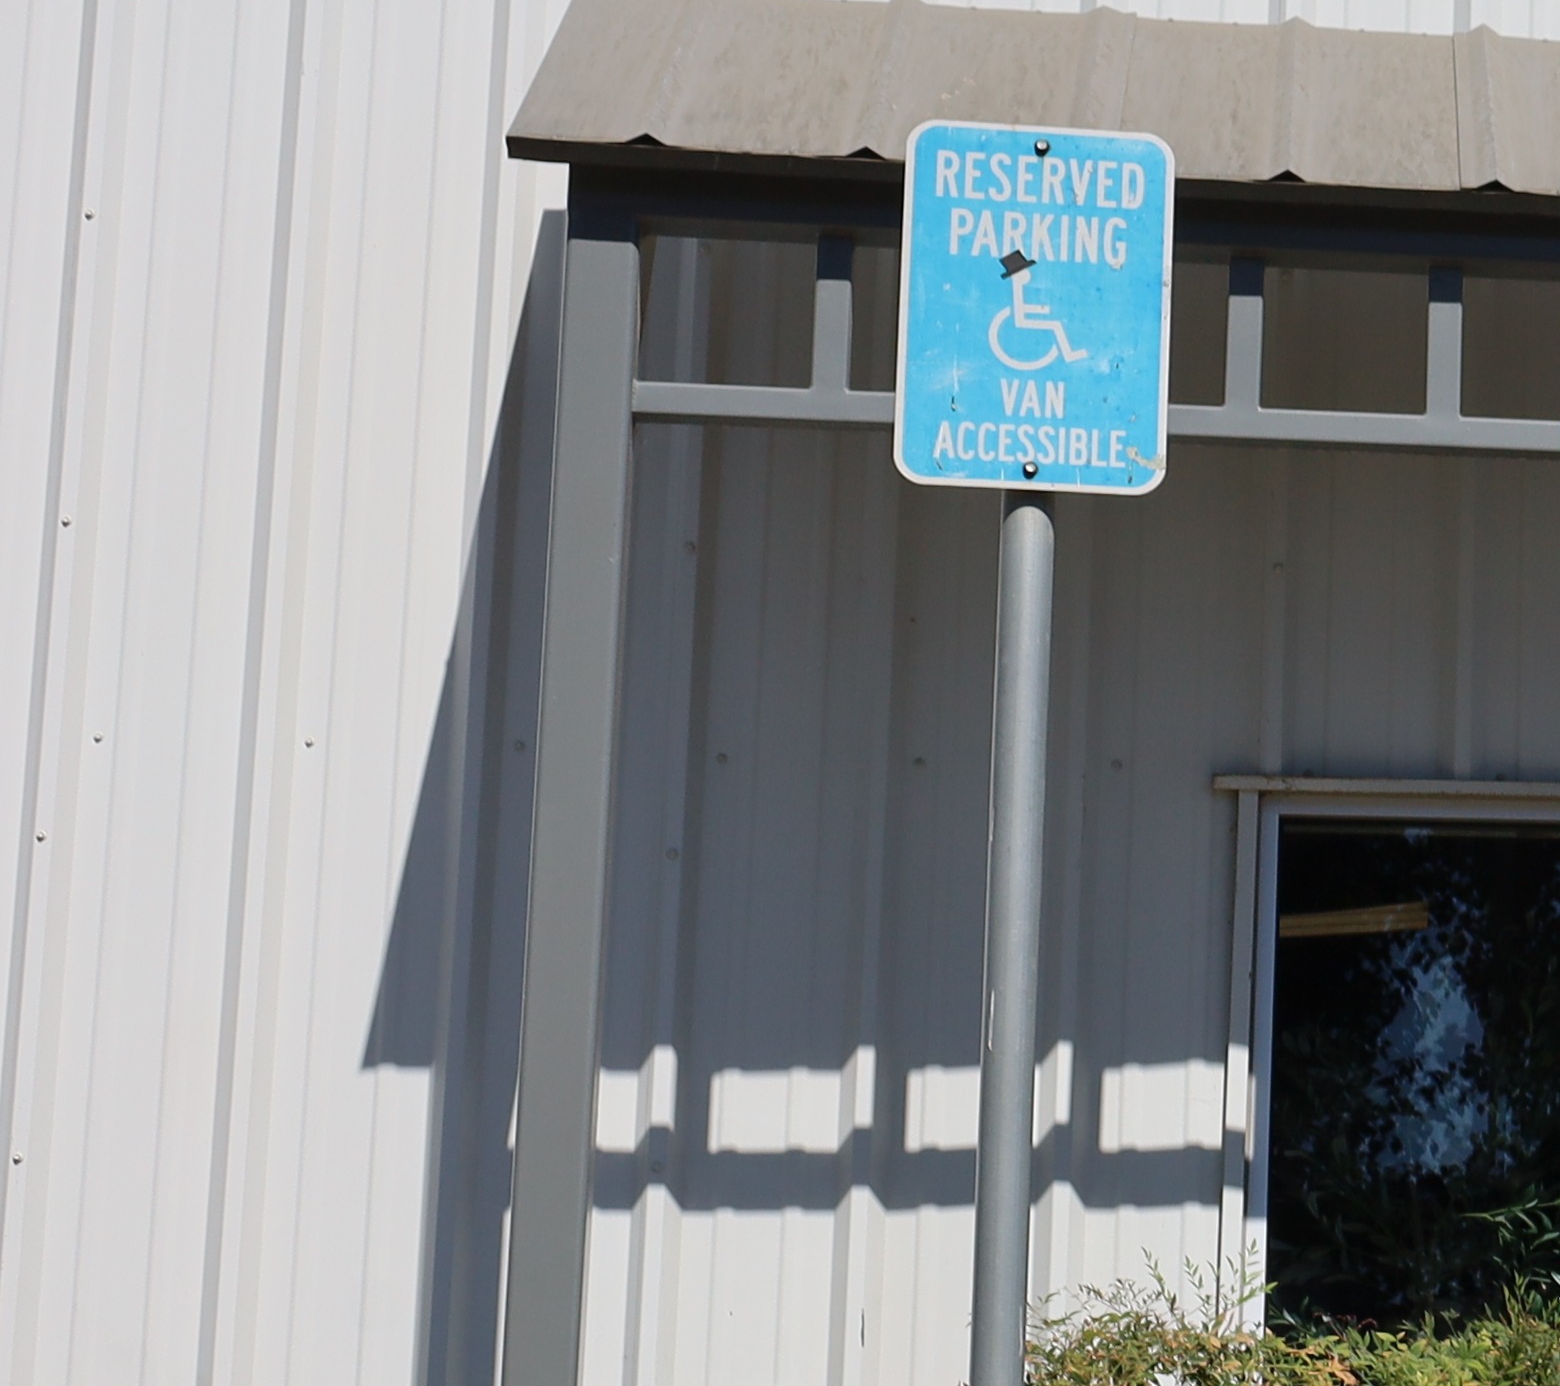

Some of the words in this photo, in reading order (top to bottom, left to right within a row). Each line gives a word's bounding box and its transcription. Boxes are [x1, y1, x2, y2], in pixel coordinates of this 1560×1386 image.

[935, 149, 1146, 210] RESERVED
[949, 208, 1128, 268] PARKING
[1000, 378, 1066, 420] VAN
[933, 420, 1127, 469] ACCESSIBLE
